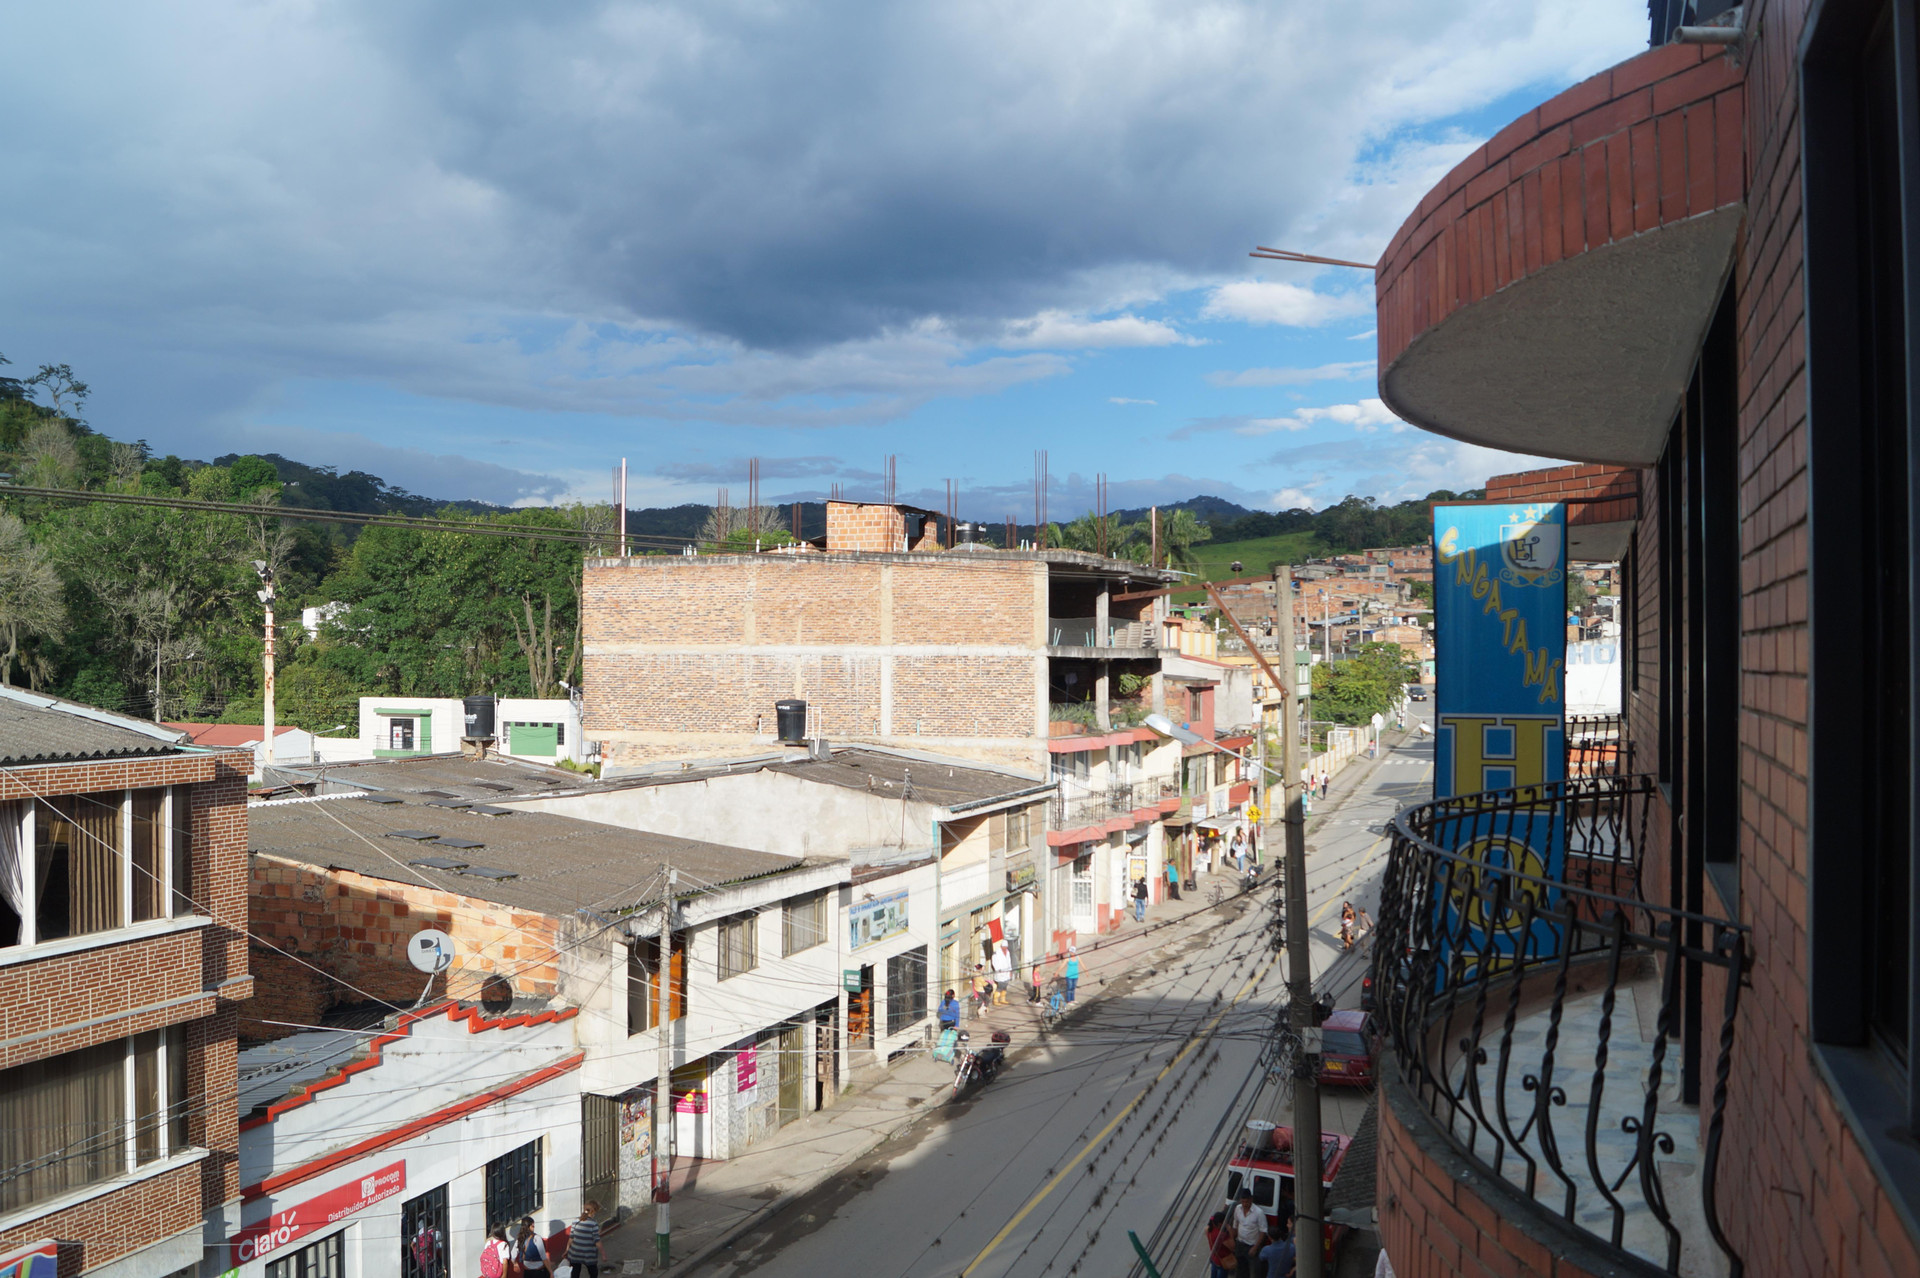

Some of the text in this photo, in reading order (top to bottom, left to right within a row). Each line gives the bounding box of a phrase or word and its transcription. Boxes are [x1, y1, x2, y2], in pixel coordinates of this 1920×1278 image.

[1438, 527, 1562, 704] ENGATAMÁ
[327, 1185, 400, 1222] Distribuidor Autorizado
[238, 1226, 291, 1261] Claro
